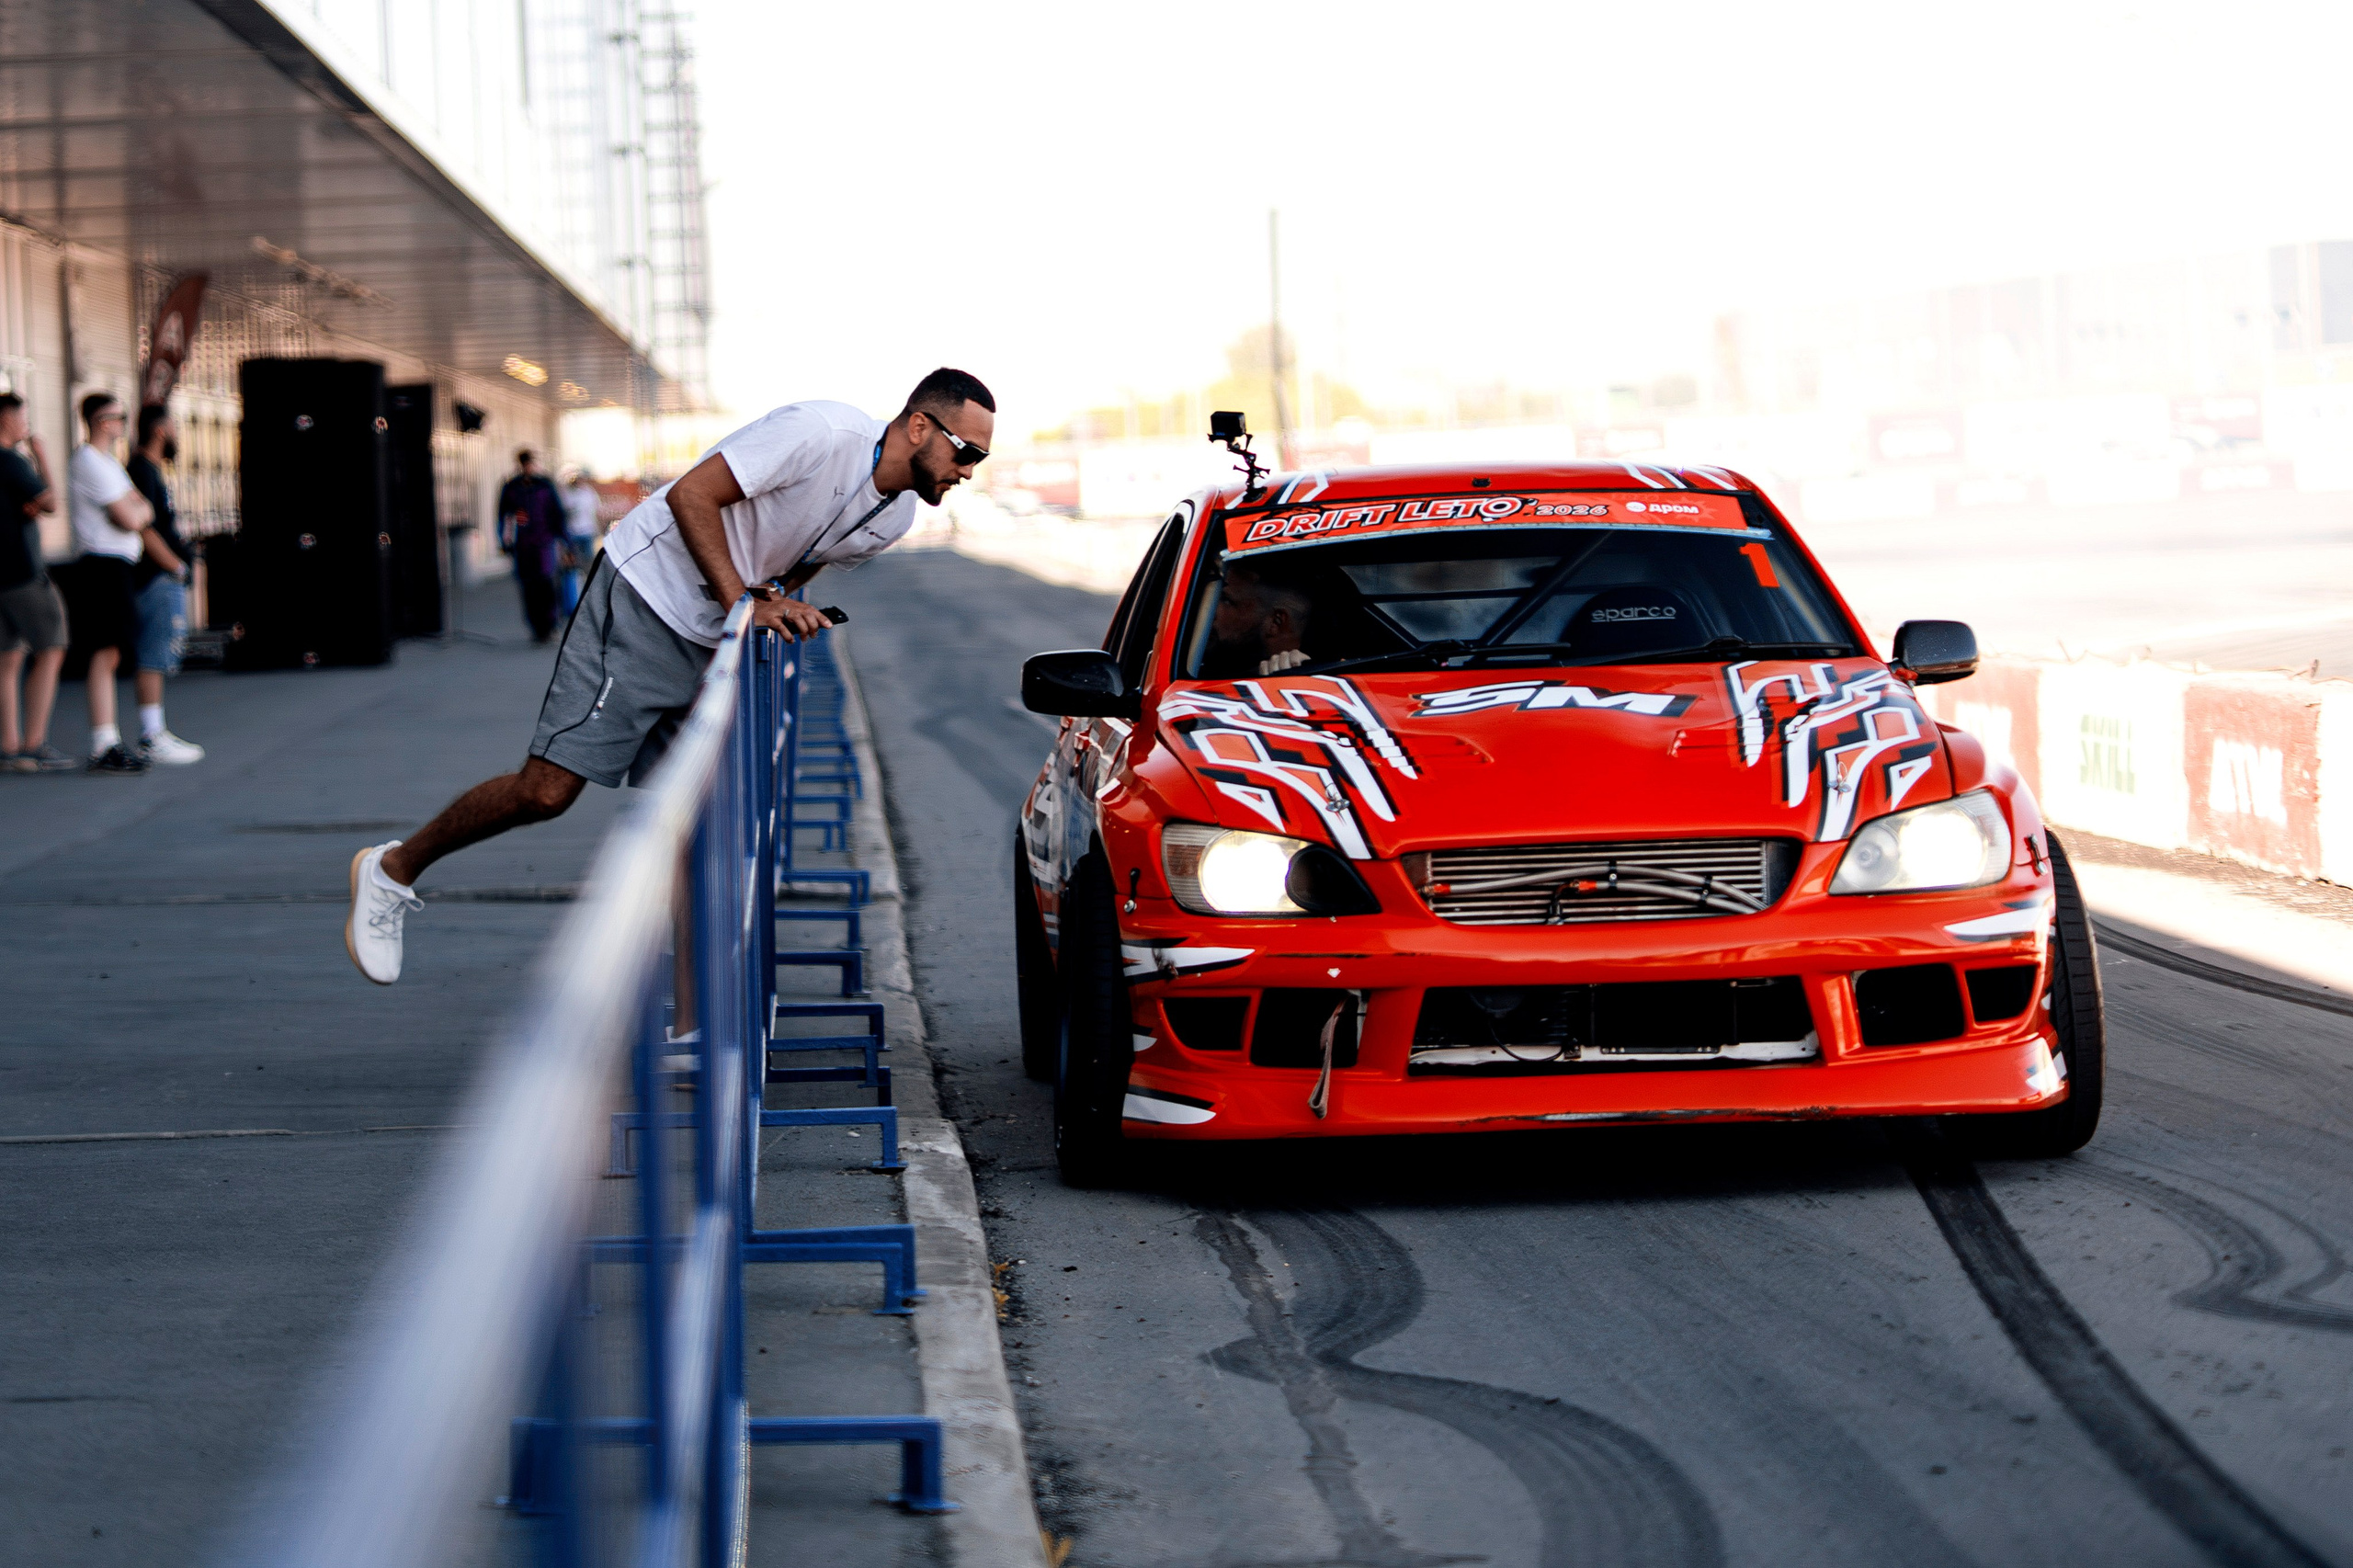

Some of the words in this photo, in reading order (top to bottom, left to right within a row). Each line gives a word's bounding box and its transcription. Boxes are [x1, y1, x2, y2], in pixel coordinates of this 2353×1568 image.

[1246, 504, 1396, 541] DRIFT
[1398, 496, 1522, 521] LETO
[1535, 505, 1608, 516] 2026
[1739, 542, 1780, 588] 1
[1592, 606, 1677, 621] sparco
